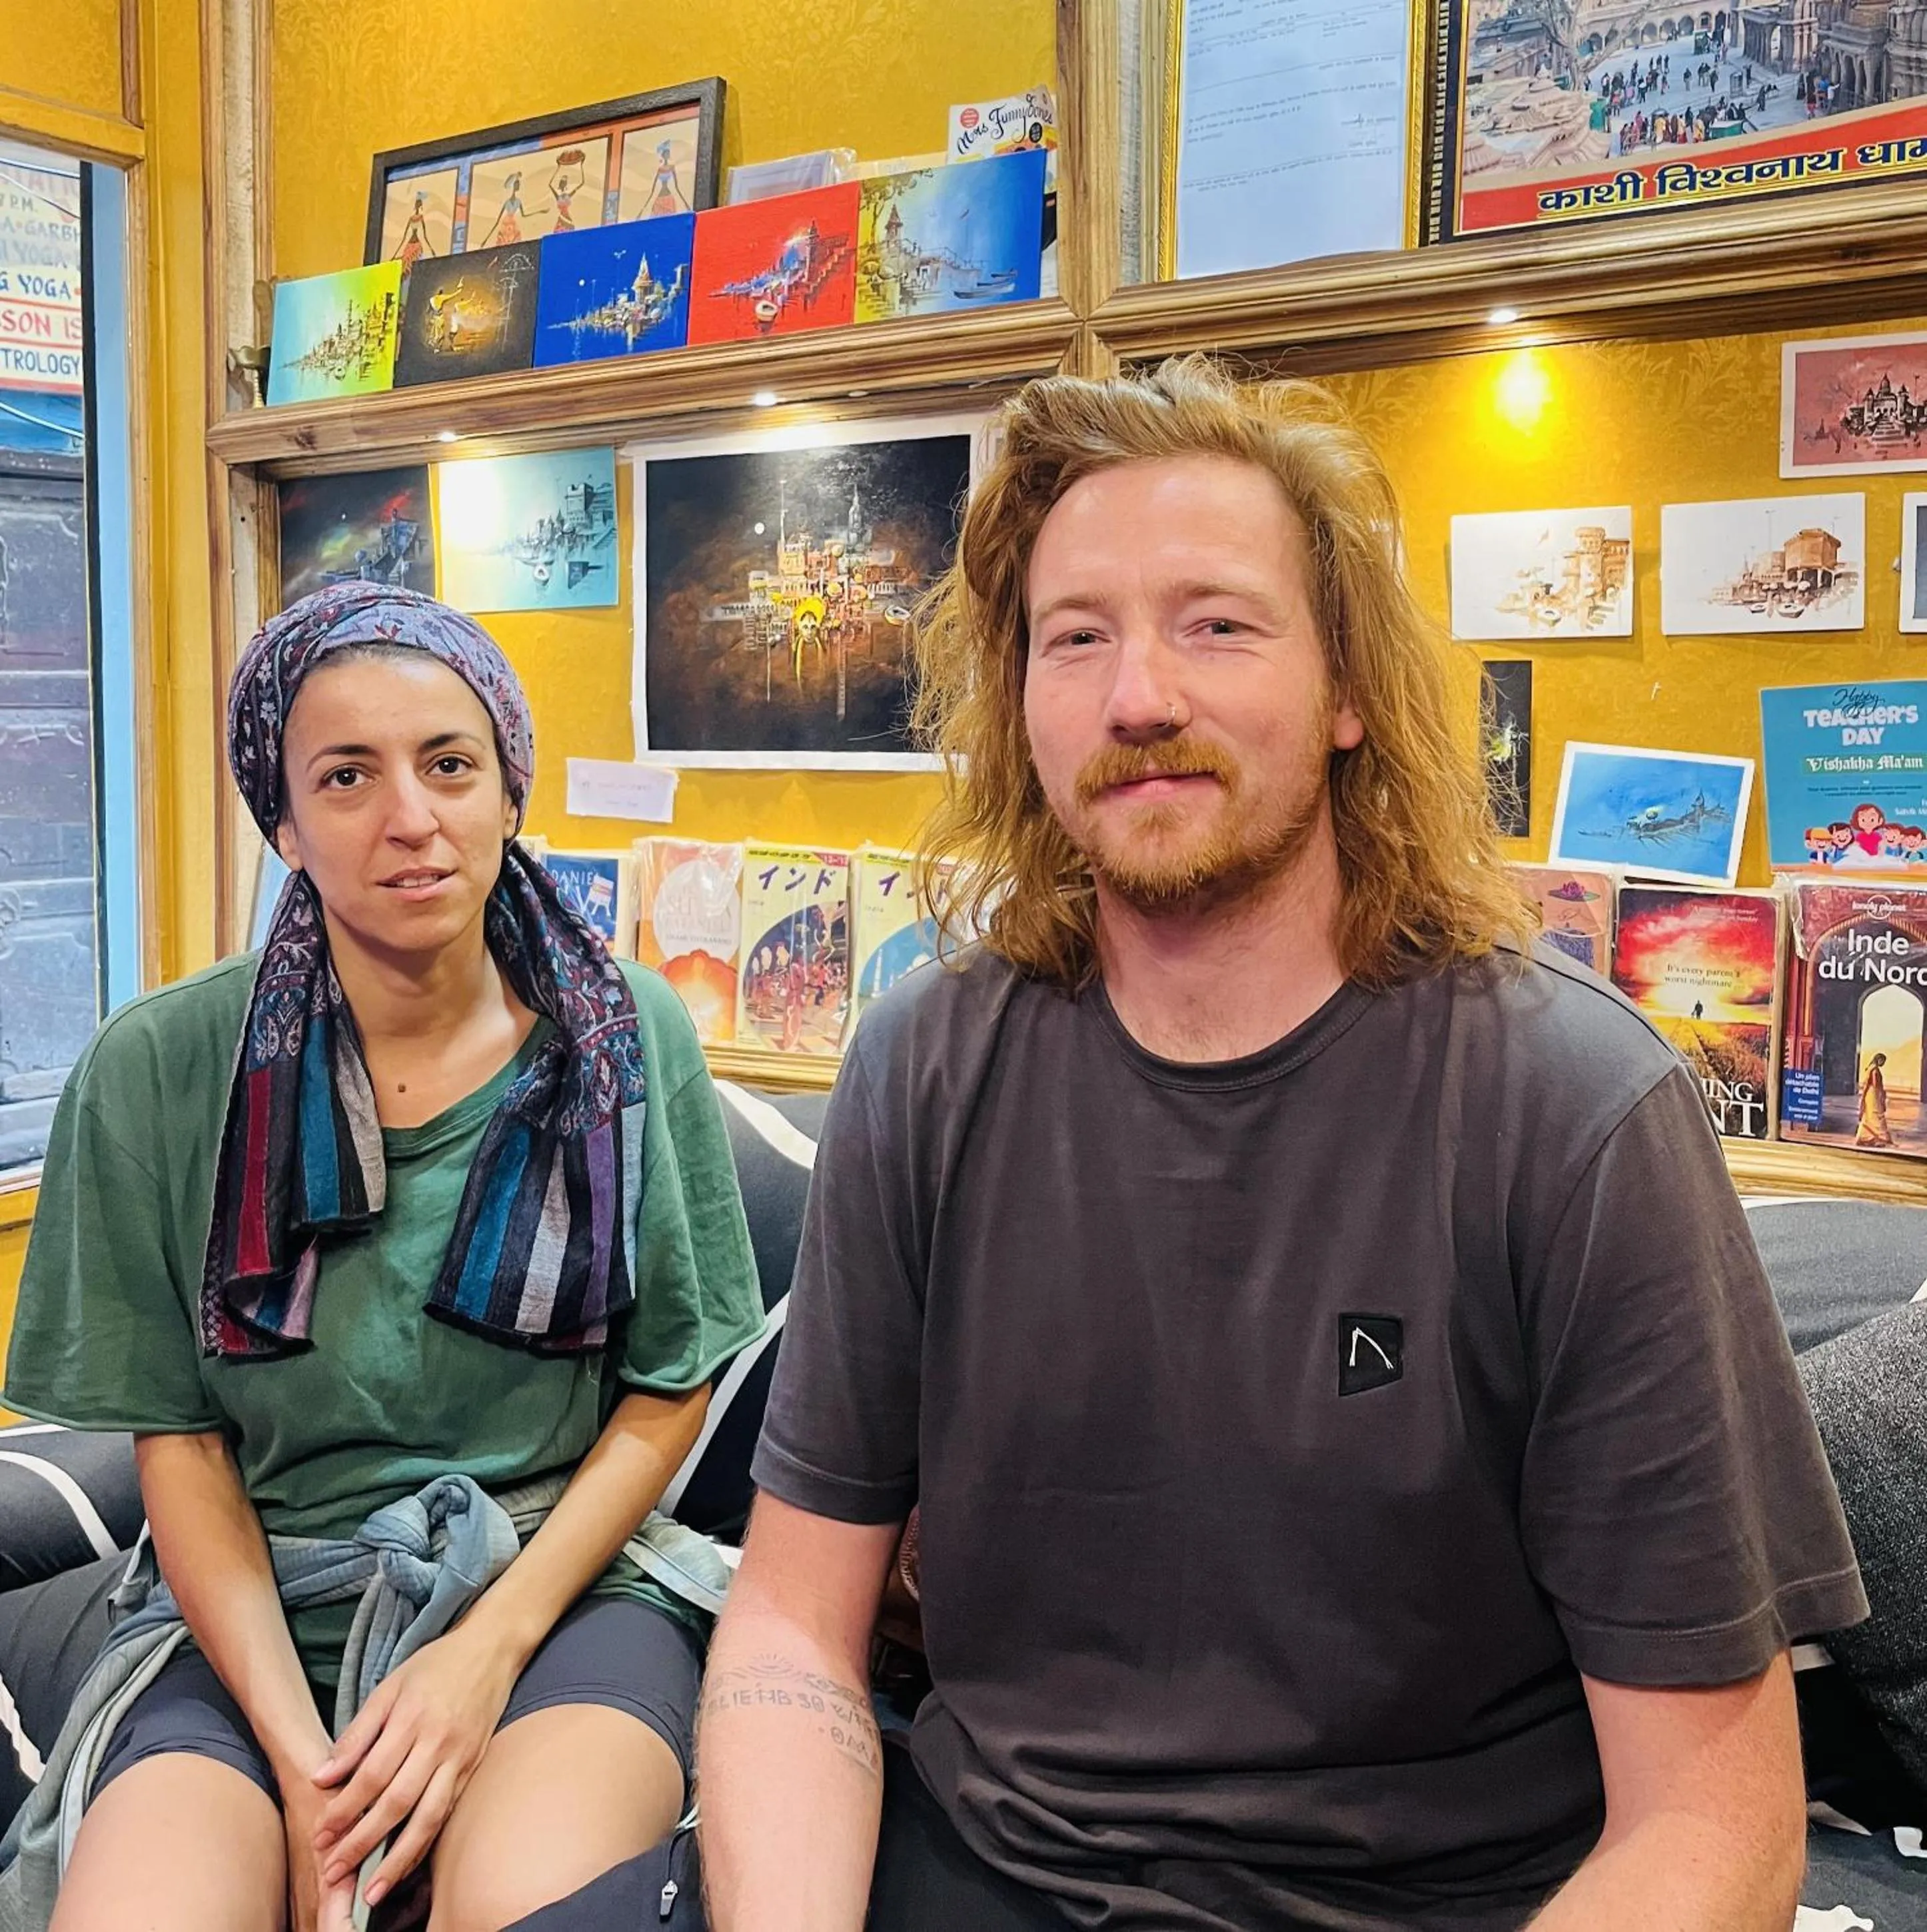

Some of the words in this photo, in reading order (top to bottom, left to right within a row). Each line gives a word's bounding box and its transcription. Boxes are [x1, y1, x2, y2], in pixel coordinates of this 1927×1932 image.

[1538, 169, 1646, 213] काशी
[1655, 148, 1846, 196] विश्वनाथ
[17, 273, 71, 300] YOGA
[1, 348, 80, 376] TROLOGY
[1832, 687, 1886, 719] Happy
[1842, 727, 1885, 746] DAY
[1806, 755, 1874, 772] Vishakha
[1876, 754, 1923, 770] Ma'am
[758, 864, 837, 895] インド
[1852, 901, 1878, 915] lonely
[1879, 901, 1906, 916] planet
[1848, 929, 1910, 955] Inde
[1667, 963, 1680, 973] It's
[1682, 967, 1703, 977] every
[1818, 955, 1855, 981] du
